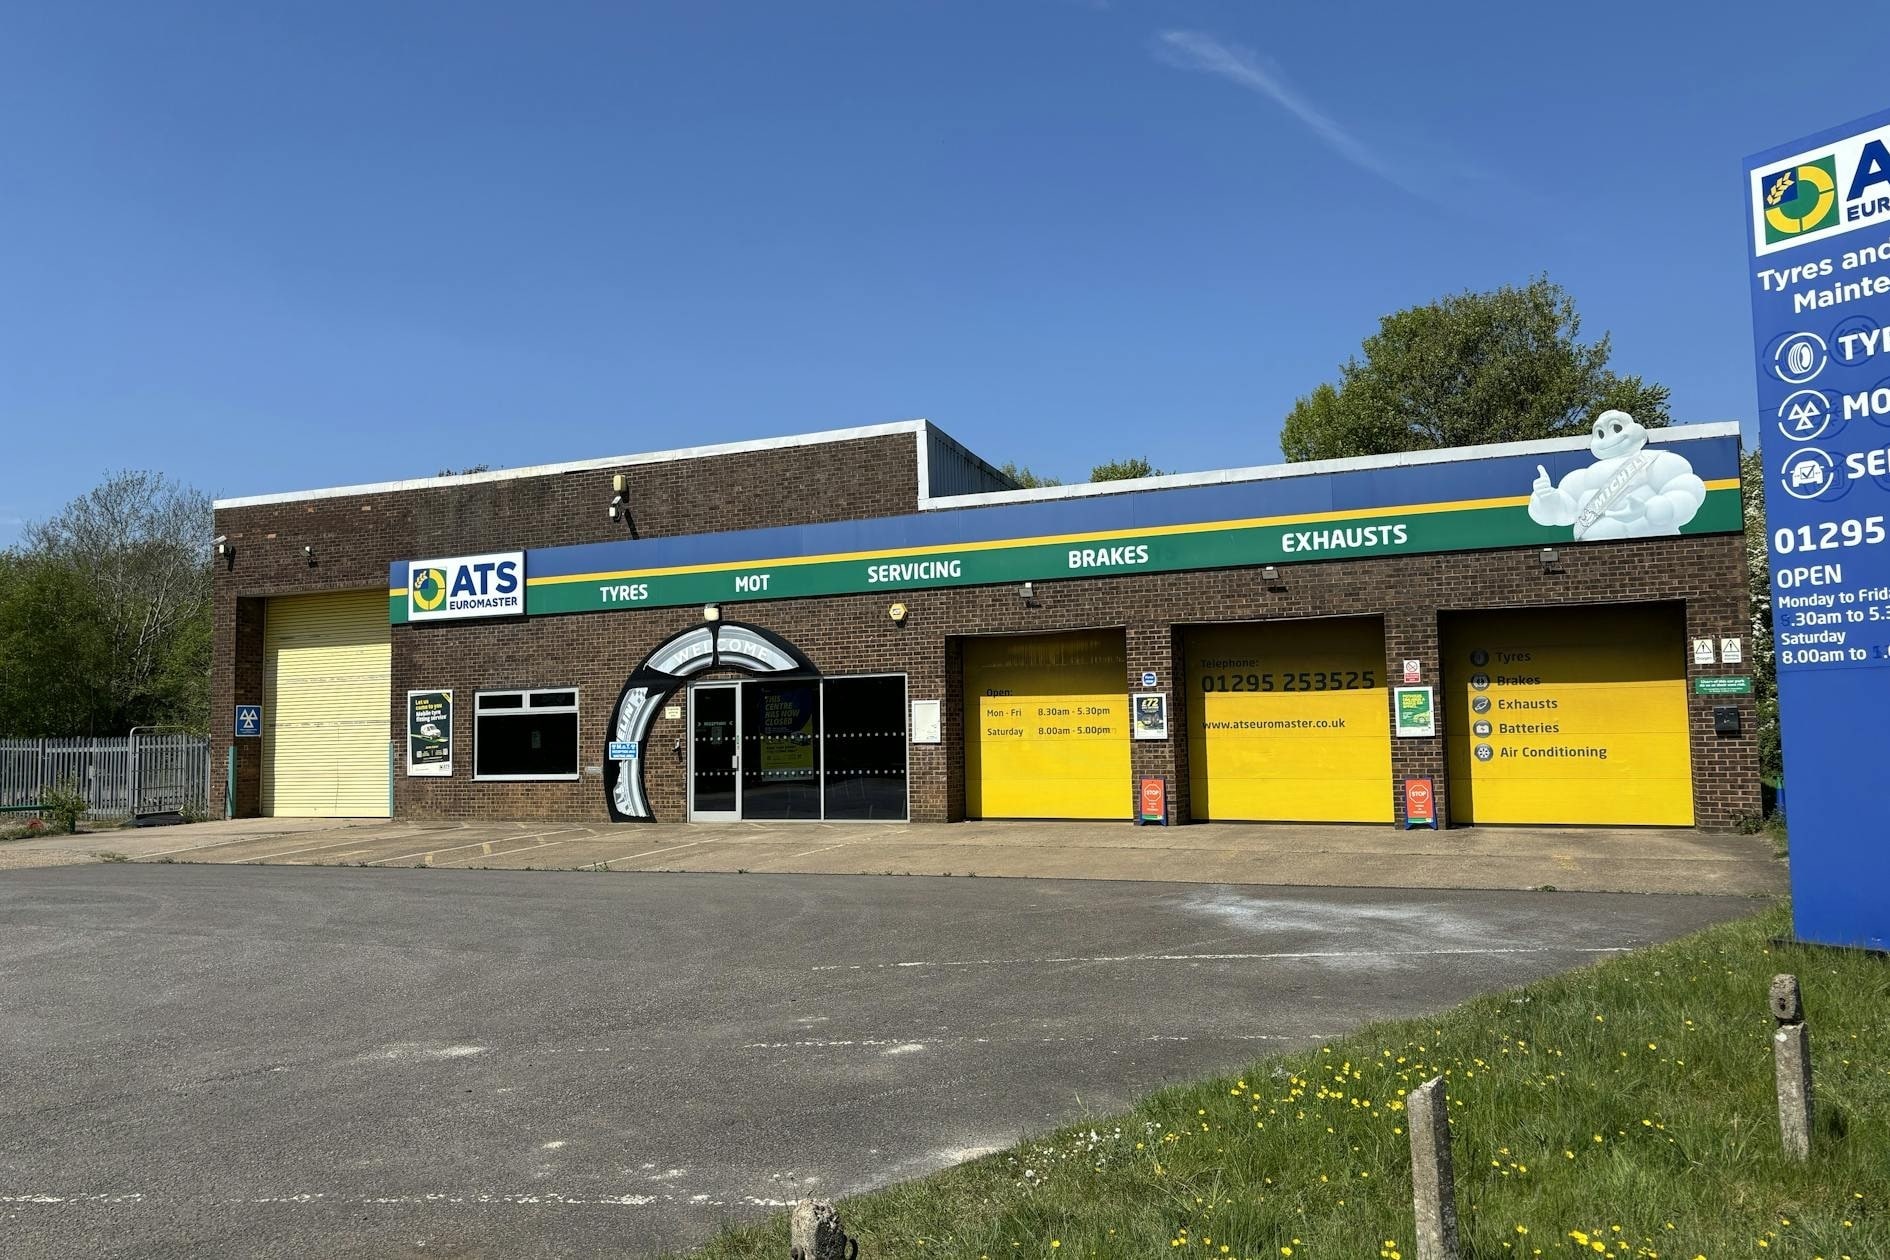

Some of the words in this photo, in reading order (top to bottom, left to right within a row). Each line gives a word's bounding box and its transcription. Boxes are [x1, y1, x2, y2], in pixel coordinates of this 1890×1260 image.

[1757, 258, 1833, 292] Tyres
[1793, 276, 1890, 314] Mainte
[1843, 388, 1890, 420] MO
[1846, 449, 1890, 479] SE
[1281, 524, 1408, 553] EXHAUSTS
[1774, 516, 1886, 554] 01295
[1068, 545, 1149, 569] BRAKES
[450, 561, 518, 597] ATS
[867, 560, 961, 583] SERVICING
[1777, 563, 1842, 589] OPEN
[735, 574, 770, 593] MOT
[600, 584, 648, 603] TYRES
[1778, 593, 1835, 609] Monday
[1838, 592, 1855, 604] to
[1858, 587, 1890, 602] Frid
[449, 596, 518, 610] EUROMASTER
[1846, 609, 1864, 622] to
[1780, 630, 1846, 646] Saturday
[1201, 659, 1259, 670] Telephone:
[1495, 652, 1532, 664] Tyres
[1782, 648, 1845, 665] 8.00am
[1848, 647, 1867, 661] to
[1201, 673, 1274, 693] 01295
[1283, 671, 1375, 692] 253525
[1497, 675, 1541, 686] Brakes
[986, 688, 1013, 698] Open:
[987, 709, 1004, 717] Mon
[1011, 708, 1021, 717] Fri
[1038, 708, 1070, 716] 8.30am
[1077, 706, 1110, 717] 5.30pm
[1141, 698, 1159, 707] £72
[1498, 699, 1558, 710] Exhausts
[987, 728, 1024, 737] Saturday
[1038, 727, 1070, 735] 8.00am
[1077, 726, 1111, 736] 5.00pm
[1202, 718, 1345, 729] www.atseuromaster.co.uk
[1499, 723, 1559, 734] Batteries
[1500, 746, 1518, 758] Air
[1522, 746, 1607, 760] Conditioning
